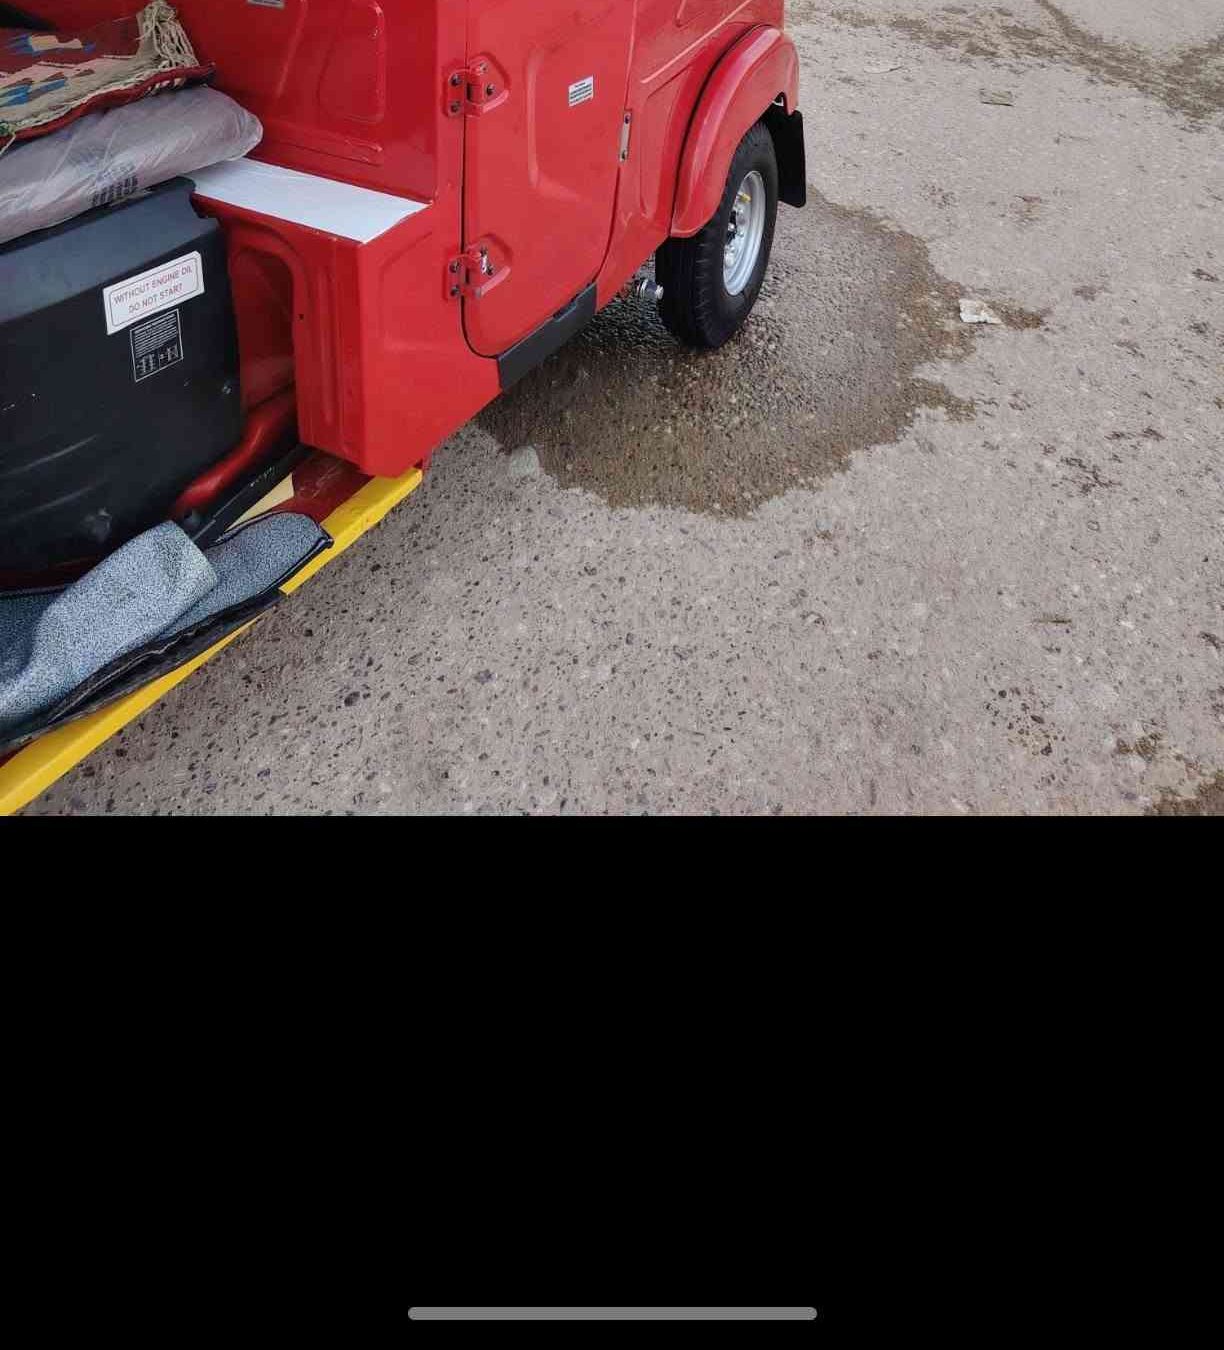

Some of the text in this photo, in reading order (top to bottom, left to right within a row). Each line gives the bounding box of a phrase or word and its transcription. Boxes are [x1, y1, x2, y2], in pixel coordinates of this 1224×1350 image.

[113, 265, 193, 305] WITHOUT ENGINE OIL
[128, 283, 183, 314] DO NOT START
